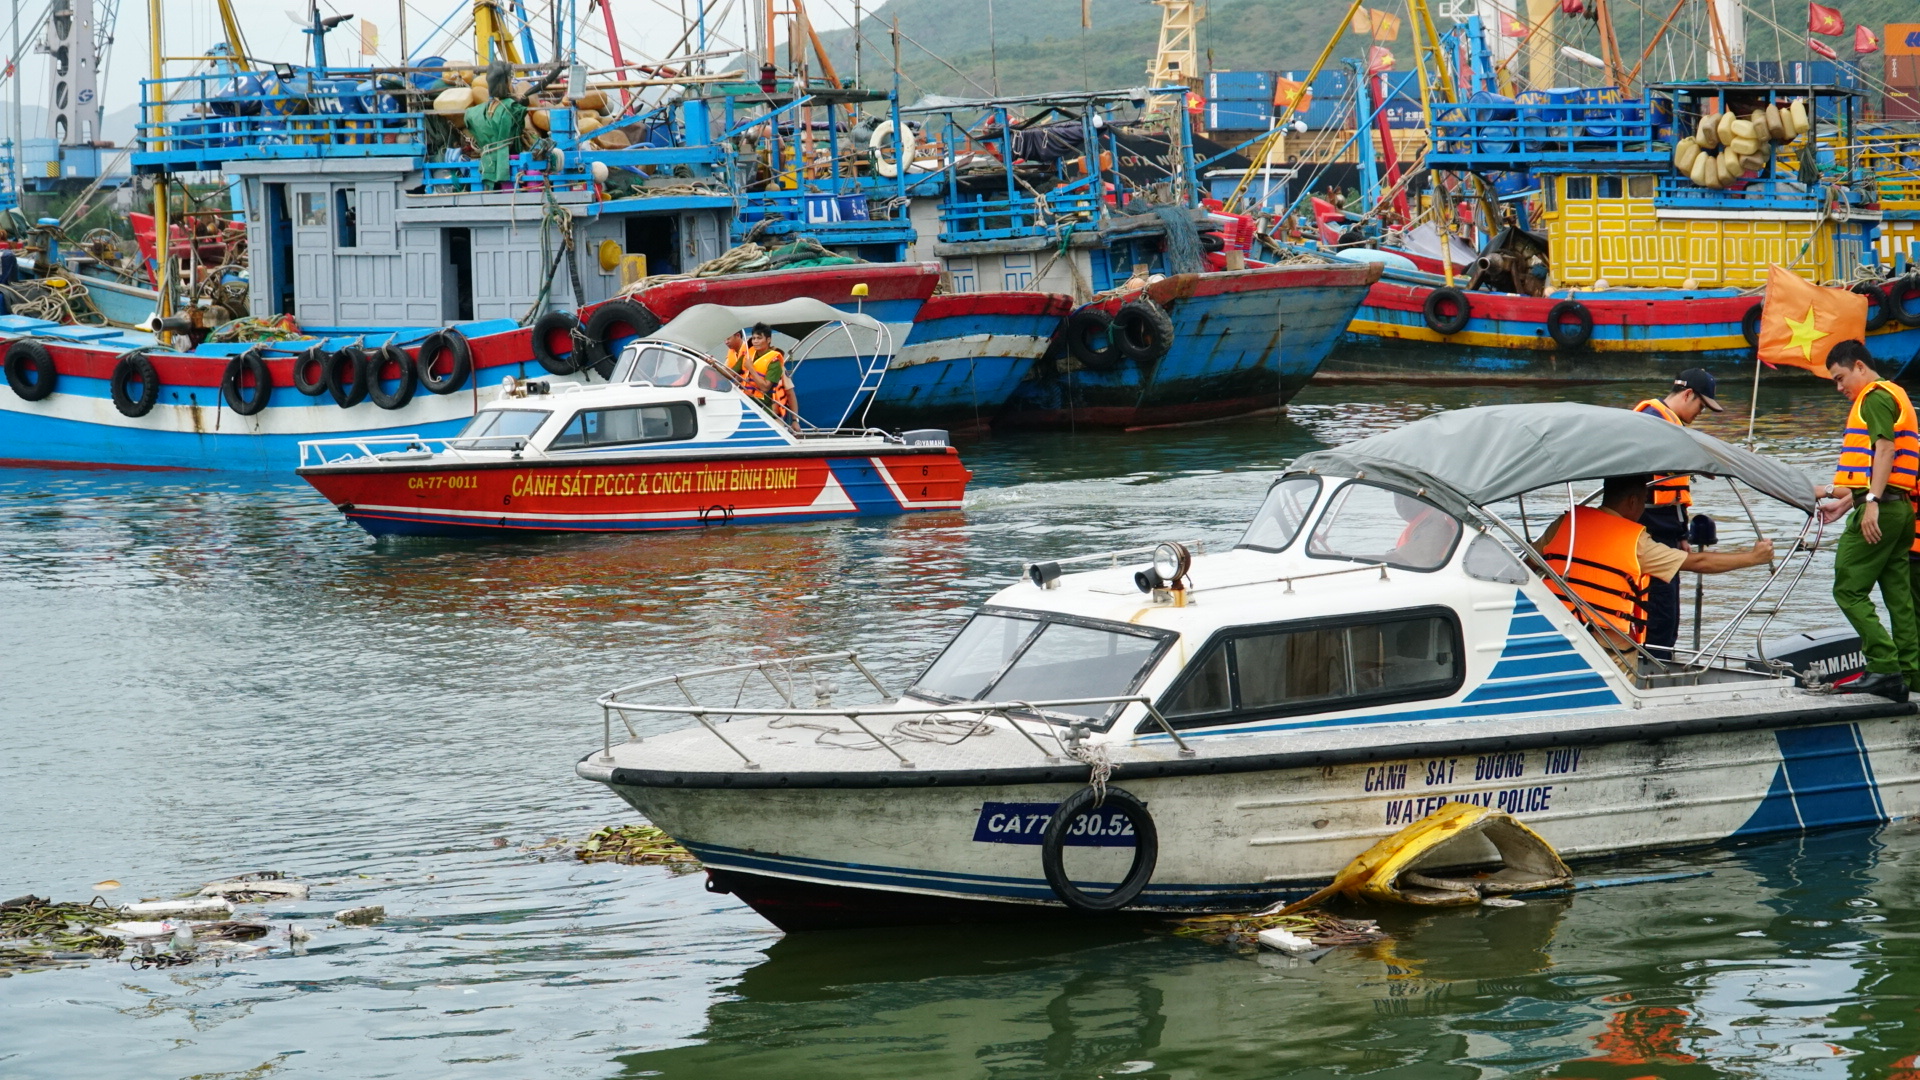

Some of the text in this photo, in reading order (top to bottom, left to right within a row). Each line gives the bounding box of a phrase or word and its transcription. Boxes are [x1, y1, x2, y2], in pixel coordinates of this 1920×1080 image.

[408, 476, 478, 489] CA-77-0011
[560, 469, 593, 496] SÁT
[595, 473, 635, 496] PCCC
[638, 473, 648, 494] &
[652, 472, 692, 494] CNCH
[696, 464, 727, 492] TỈNH
[730, 464, 763, 491] BÌNH
[765, 467, 798, 494] ĐỊNH
[503, 495, 511, 505] 6
[1498, 787, 1552, 815] POLICE
